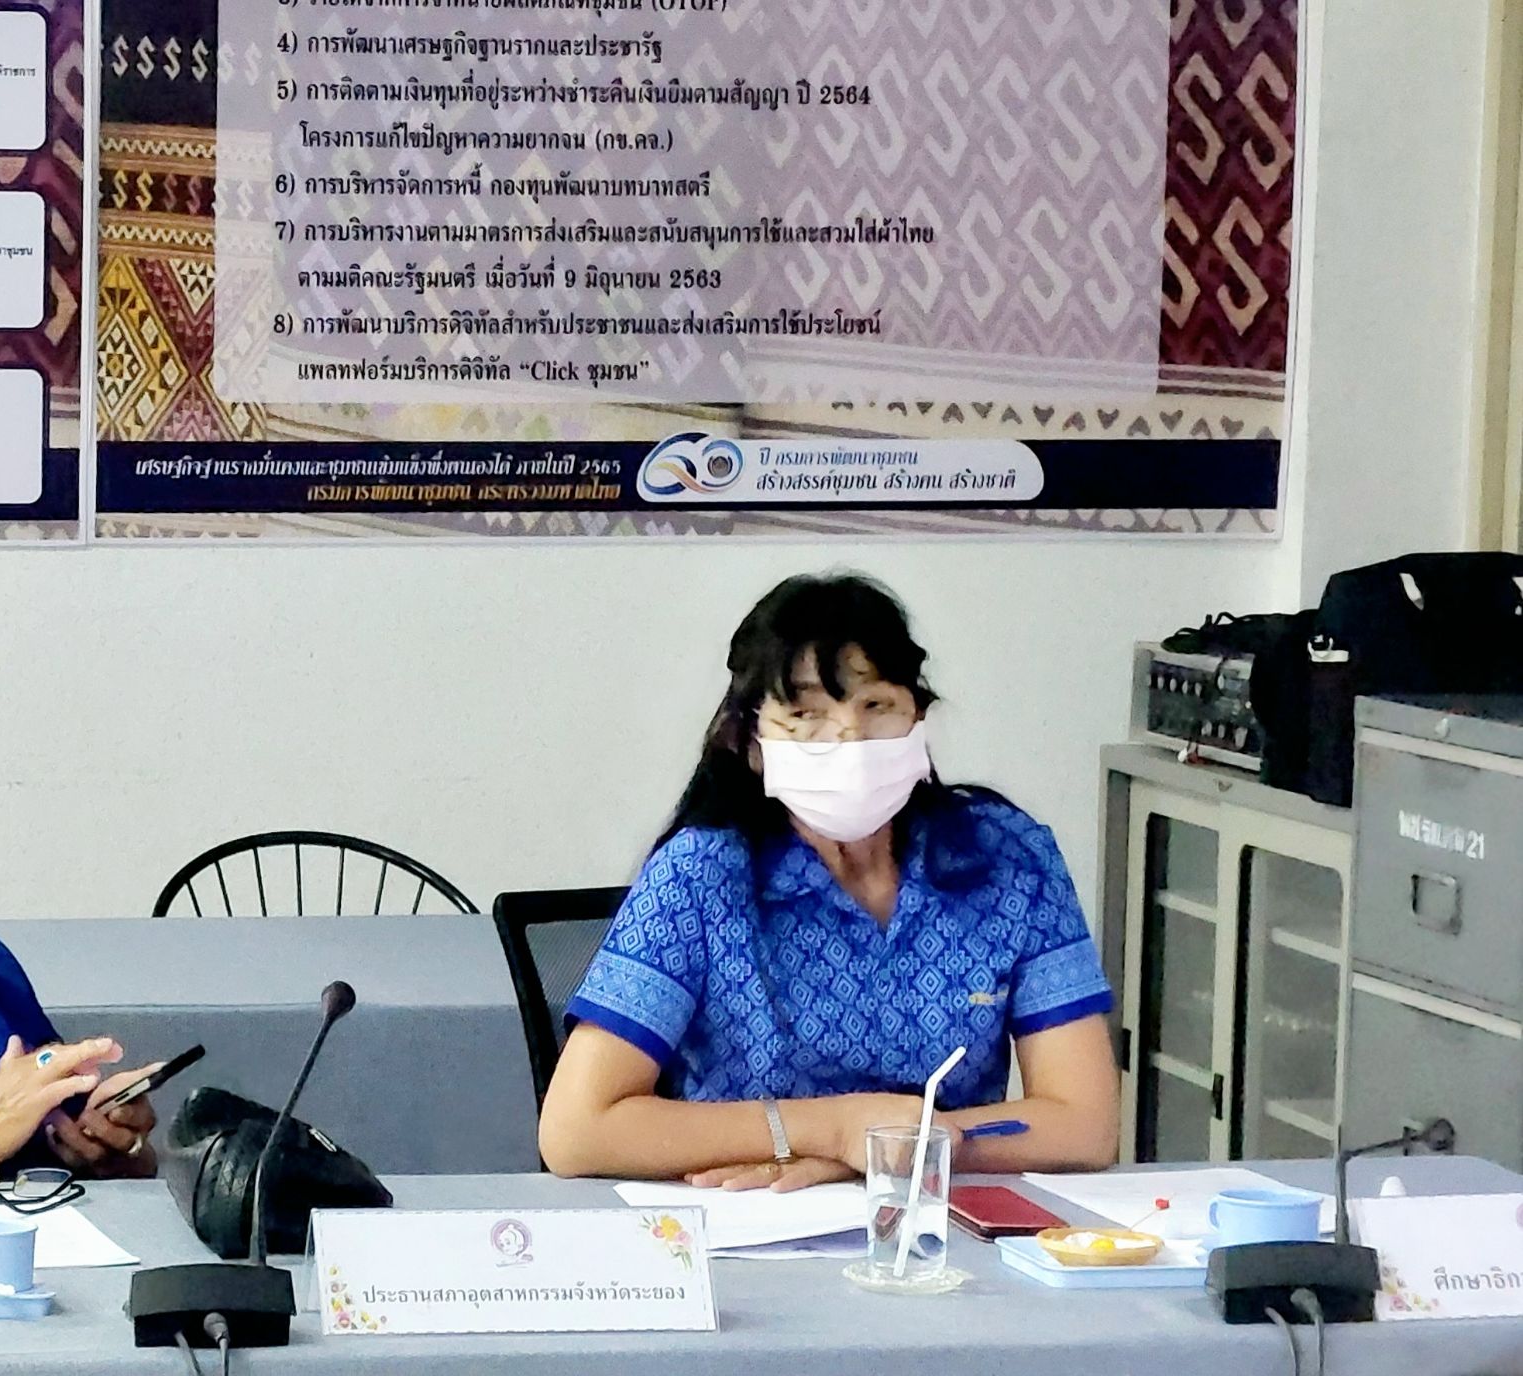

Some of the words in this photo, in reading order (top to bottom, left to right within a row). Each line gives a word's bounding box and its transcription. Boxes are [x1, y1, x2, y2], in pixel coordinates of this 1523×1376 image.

[276, 30, 298, 54] 4)
[306, 27, 663, 63] การพัฒนาเศรษฐกิจฐานรากและประชารัฐ
[276, 78, 297, 102] 5)
[305, 69, 790, 111] การติดตามเงินทุนที่อยู่ระหว่างชำระคืนเงินยืมตามสัญญา
[795, 78, 812, 105] ปี
[818, 85, 872, 106] 2564
[297, 120, 586, 156] โครงการแก้ไขปัญหาความยากจน
[594, 128, 674, 152] (กข.คจ.)
[275, 173, 295, 196] 6)
[303, 163, 483, 197] การบริหารจัดการหนี้
[489, 169, 711, 204] กองทุนพัฒนาบทบาทสตรี
[274, 219, 295, 244] 7)
[303, 215, 935, 250] การบริหารงานตามมาตรการส่งเสริมและสนับสนุนการใช้และสวมใส่ผ้าไทย
[296, 261, 477, 295] ตามมติคณะรัฐมนตรี
[483, 254, 556, 292] เมื่อวันที่
[563, 268, 577, 289] 9
[583, 264, 661, 297] มิถุนายน
[669, 268, 723, 290] 2563
[273, 313, 295, 337] 8)
[302, 308, 883, 336] การพัฒนาบริการดิจิทัลสำหรับประชาชนและส่งเสริมการใช้ประโยชน์
[297, 355, 513, 382] แพลทฟอร์มบริการดิจิทัล
[517, 358, 580, 382] “Click
[586, 361, 651, 389] ชุมชน”
[135, 449, 514, 481] เศรษฐกิจฐานรากมั่นคงและชุมชนเข้มแข็งพึ่งตนเองได้
[516, 452, 576, 475] ภายในปี
[579, 459, 621, 475] 2565
[760, 448, 771, 465] ปี
[776, 447, 918, 470] กรมการพัฒนาชุมชน
[307, 479, 472, 507] กรมการพัฒนาชุมชน
[478, 475, 621, 501] กระทรวงมหาดไทย
[757, 469, 878, 495] สร้างสรรค์ชุมชน
[884, 470, 943, 490] สร้างคน
[949, 469, 1016, 490] สร้างชาติ
[1434, 1266, 1523, 1290] ศึกษาธิก
[363, 1281, 686, 1309] ประธานสภาอุตสาหกรรมจังหวัดระยอง
